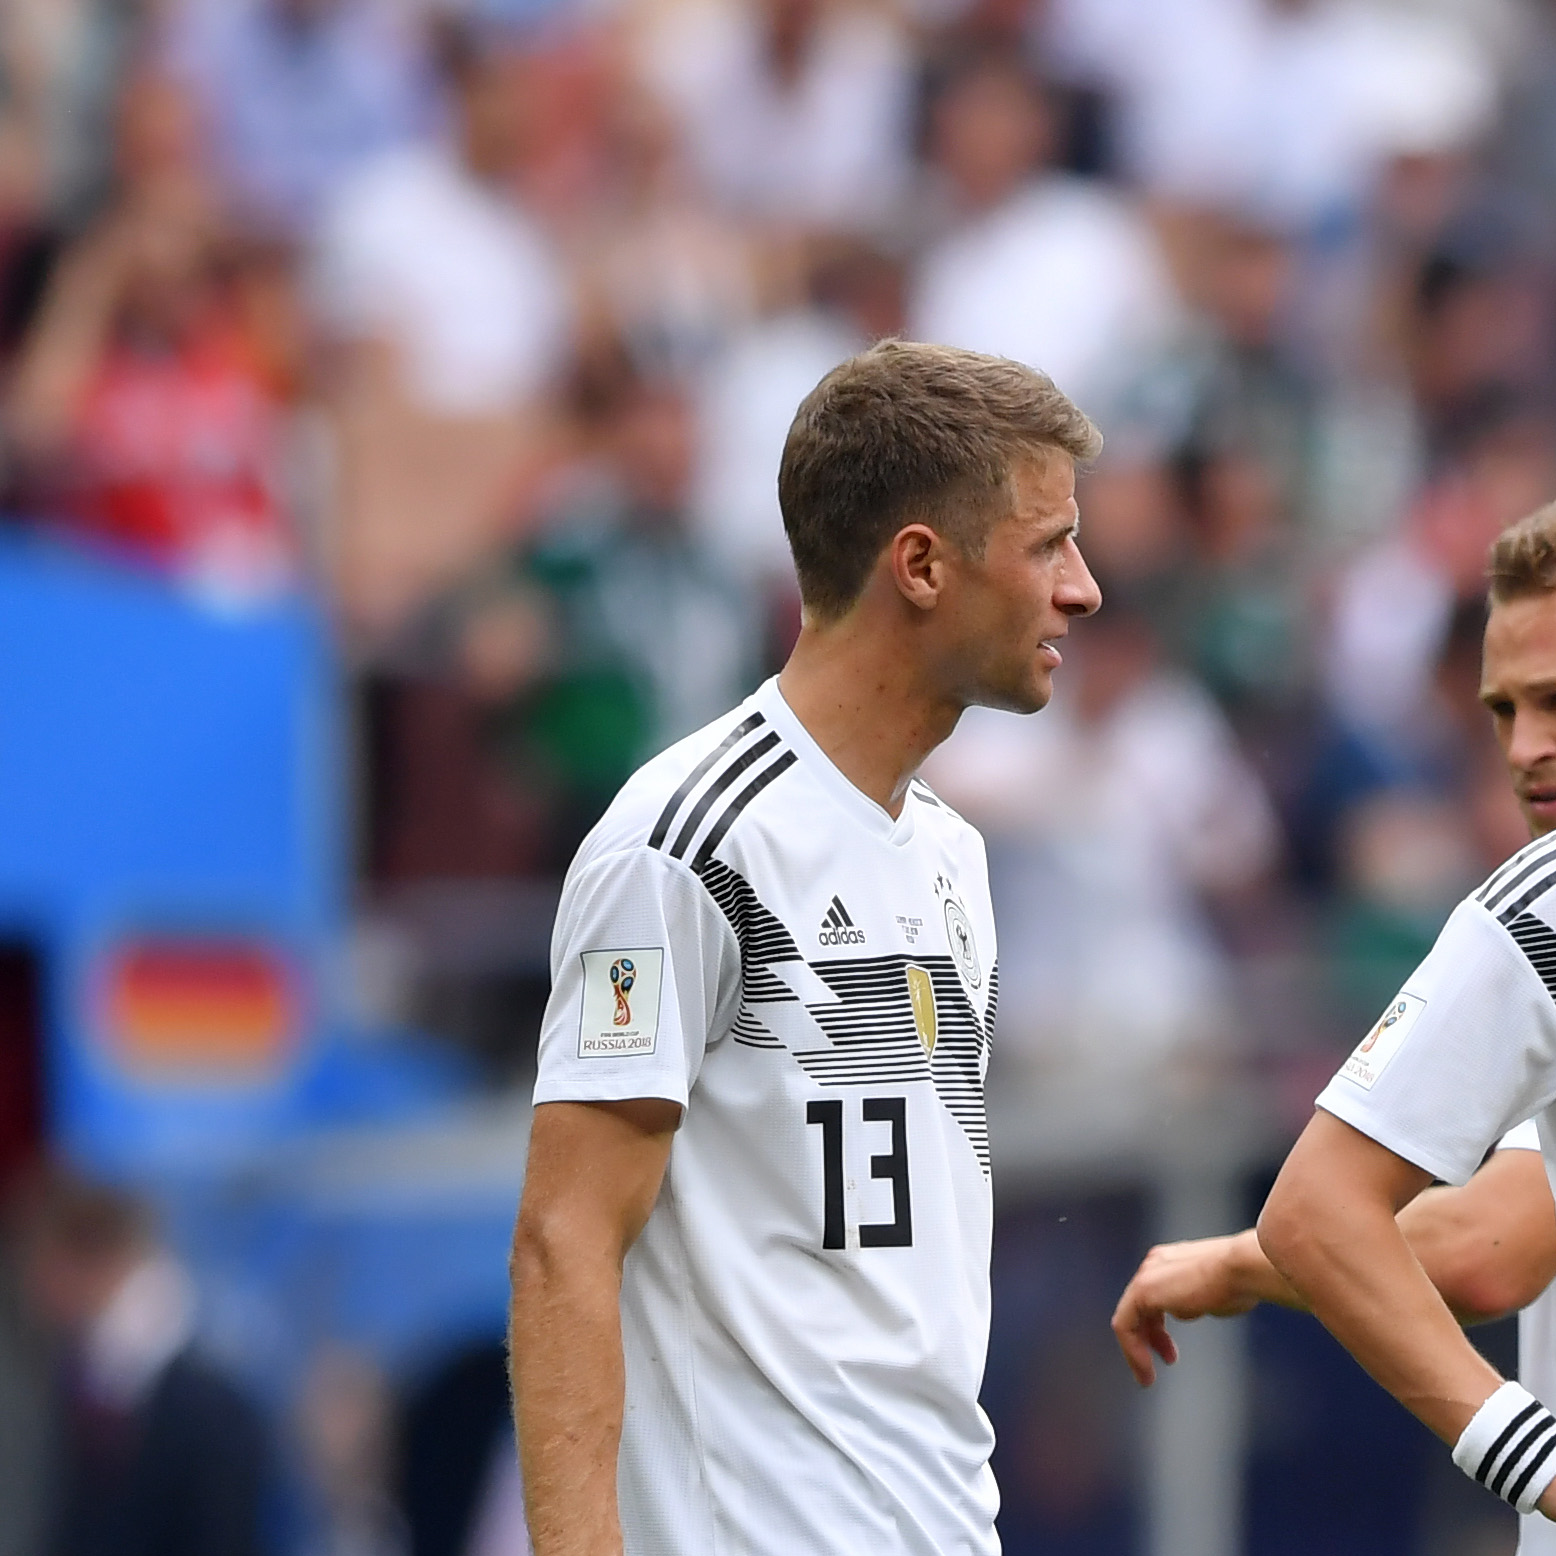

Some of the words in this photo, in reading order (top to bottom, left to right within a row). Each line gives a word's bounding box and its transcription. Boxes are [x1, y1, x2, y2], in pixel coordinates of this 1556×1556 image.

[819, 927, 865, 946] adidas
[584, 1039, 626, 1050] RUSSIA
[628, 1037, 651, 1048] 2018
[806, 1097, 912, 1249] 13
